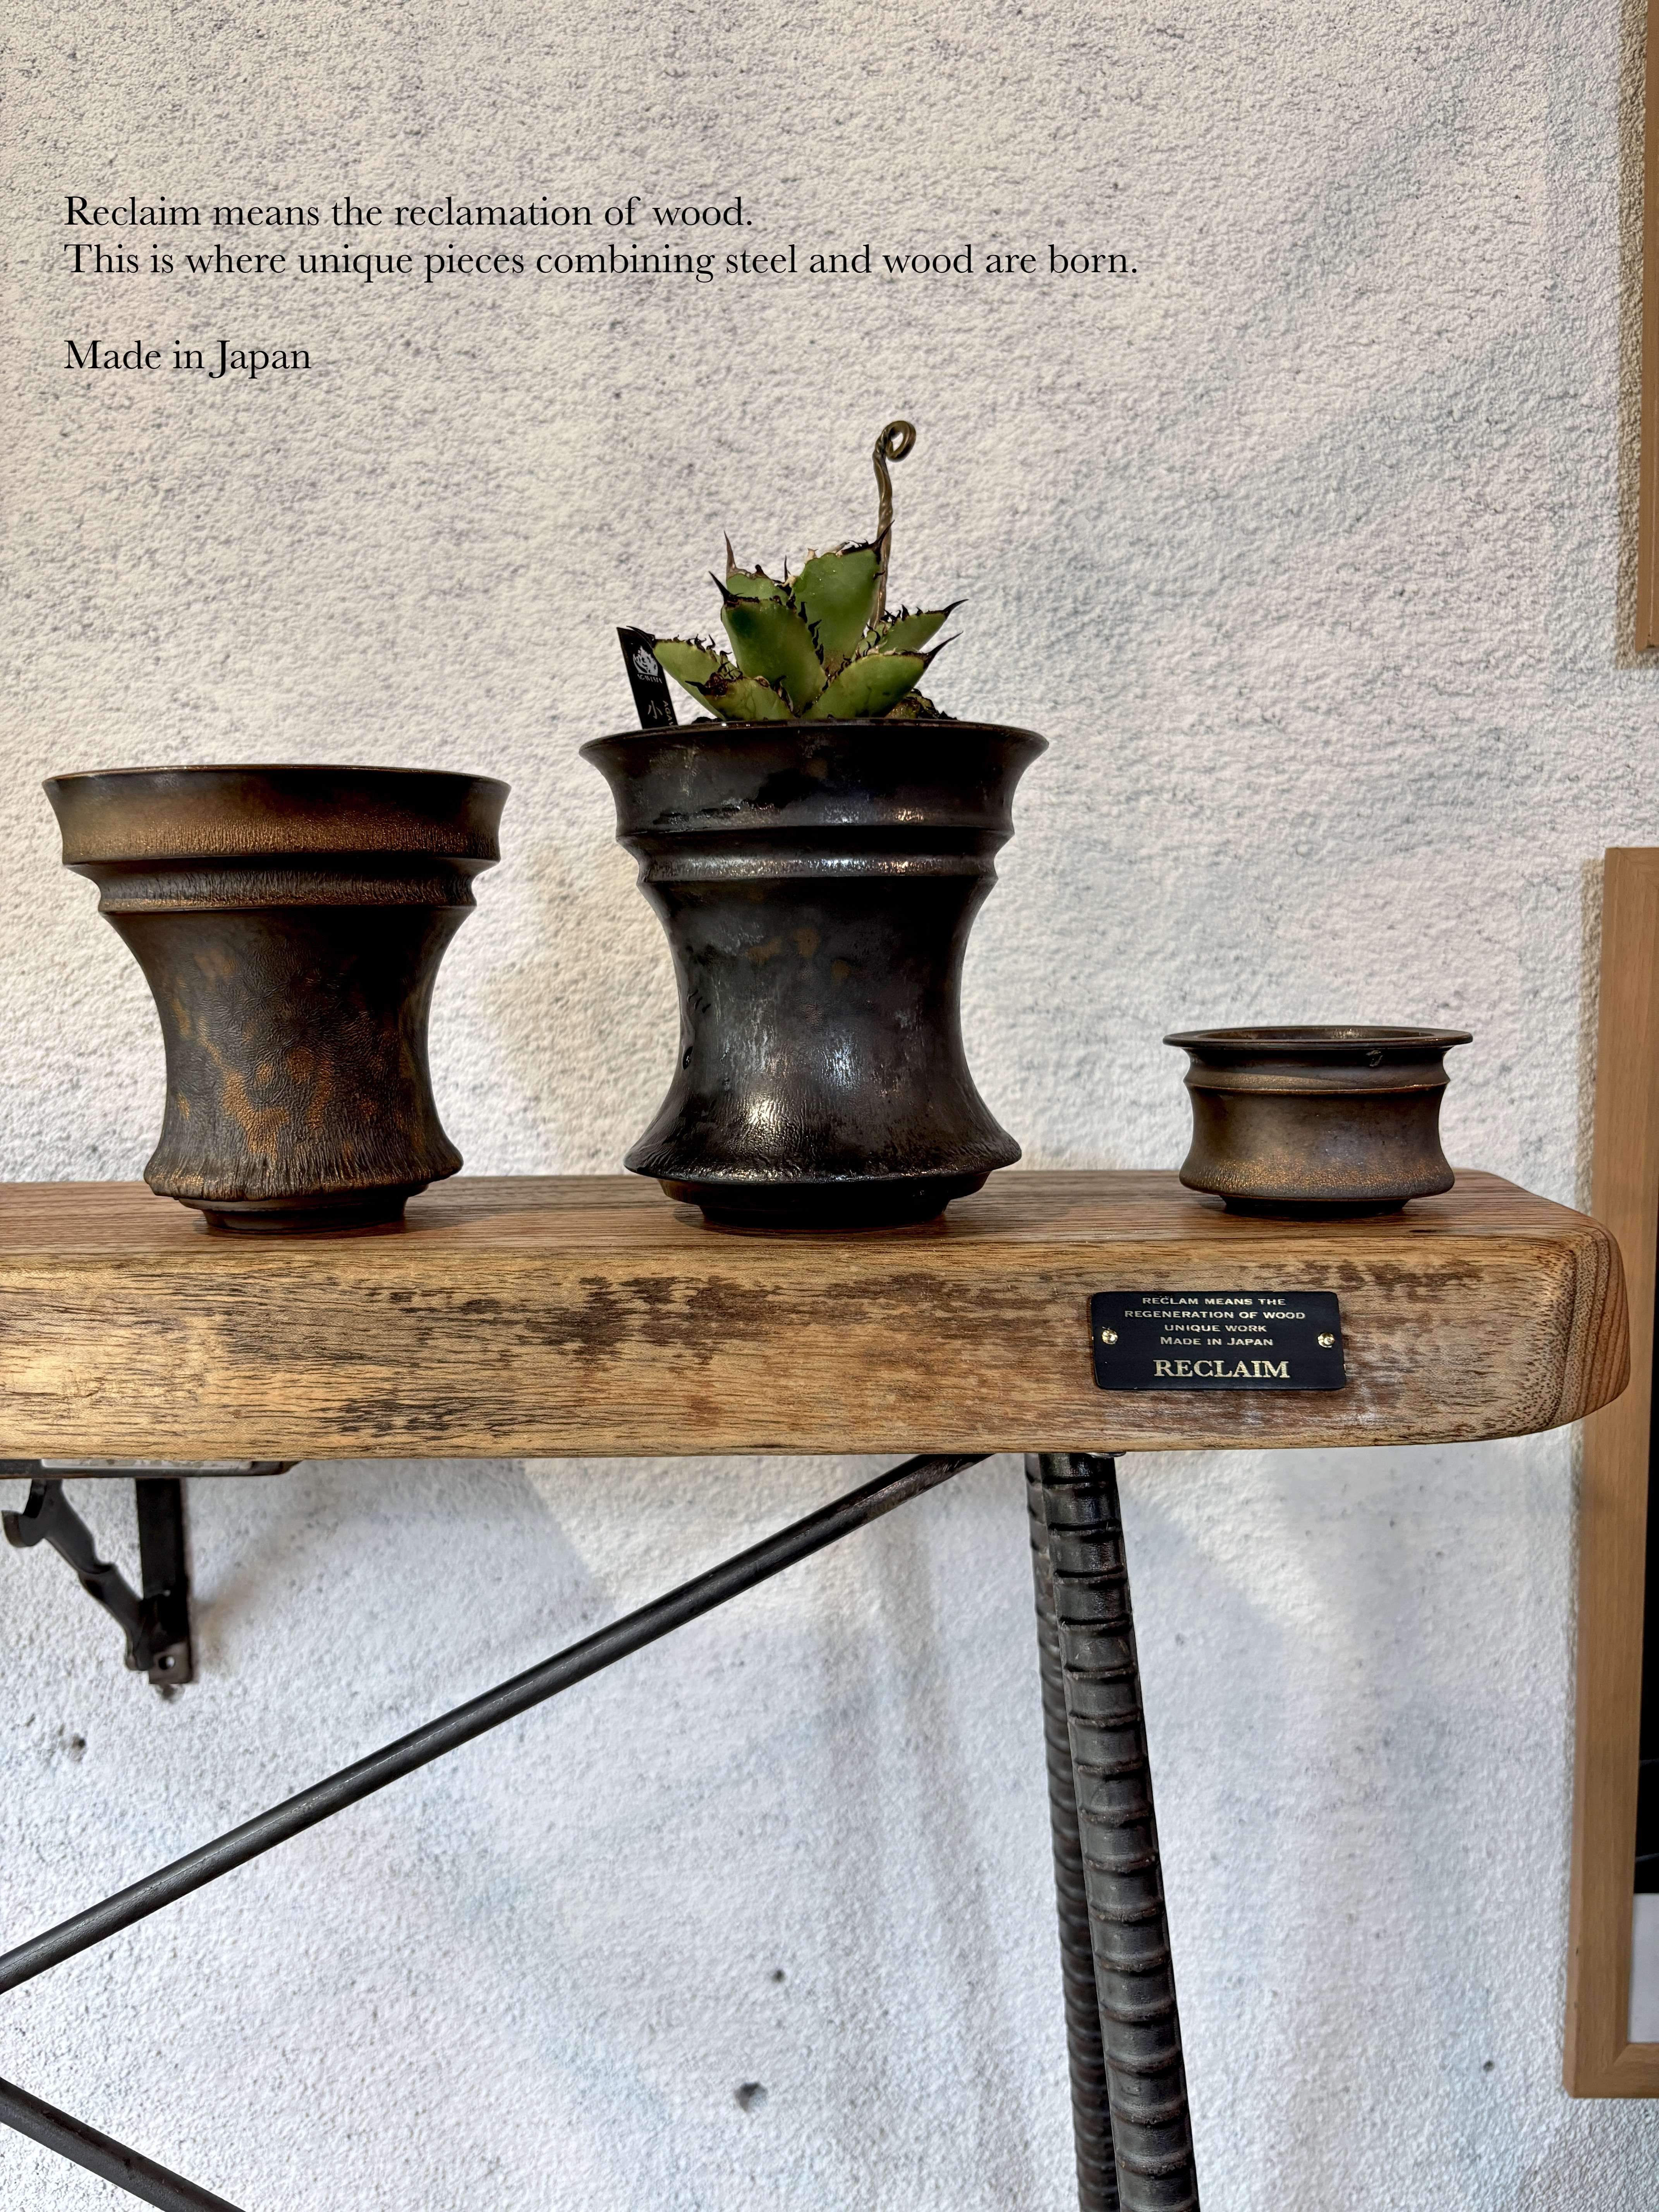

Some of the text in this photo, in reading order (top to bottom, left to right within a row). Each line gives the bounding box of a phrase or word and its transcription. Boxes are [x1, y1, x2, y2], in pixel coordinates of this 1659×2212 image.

[1142, 1297, 1199, 1305] RECLAM
[1124, 1310, 1305, 1320] REGENERATION OF WOOD
[1164, 1324, 1267, 1333] UNIQUE WORK
[1152, 1359, 1291, 1378] RECLAIM
